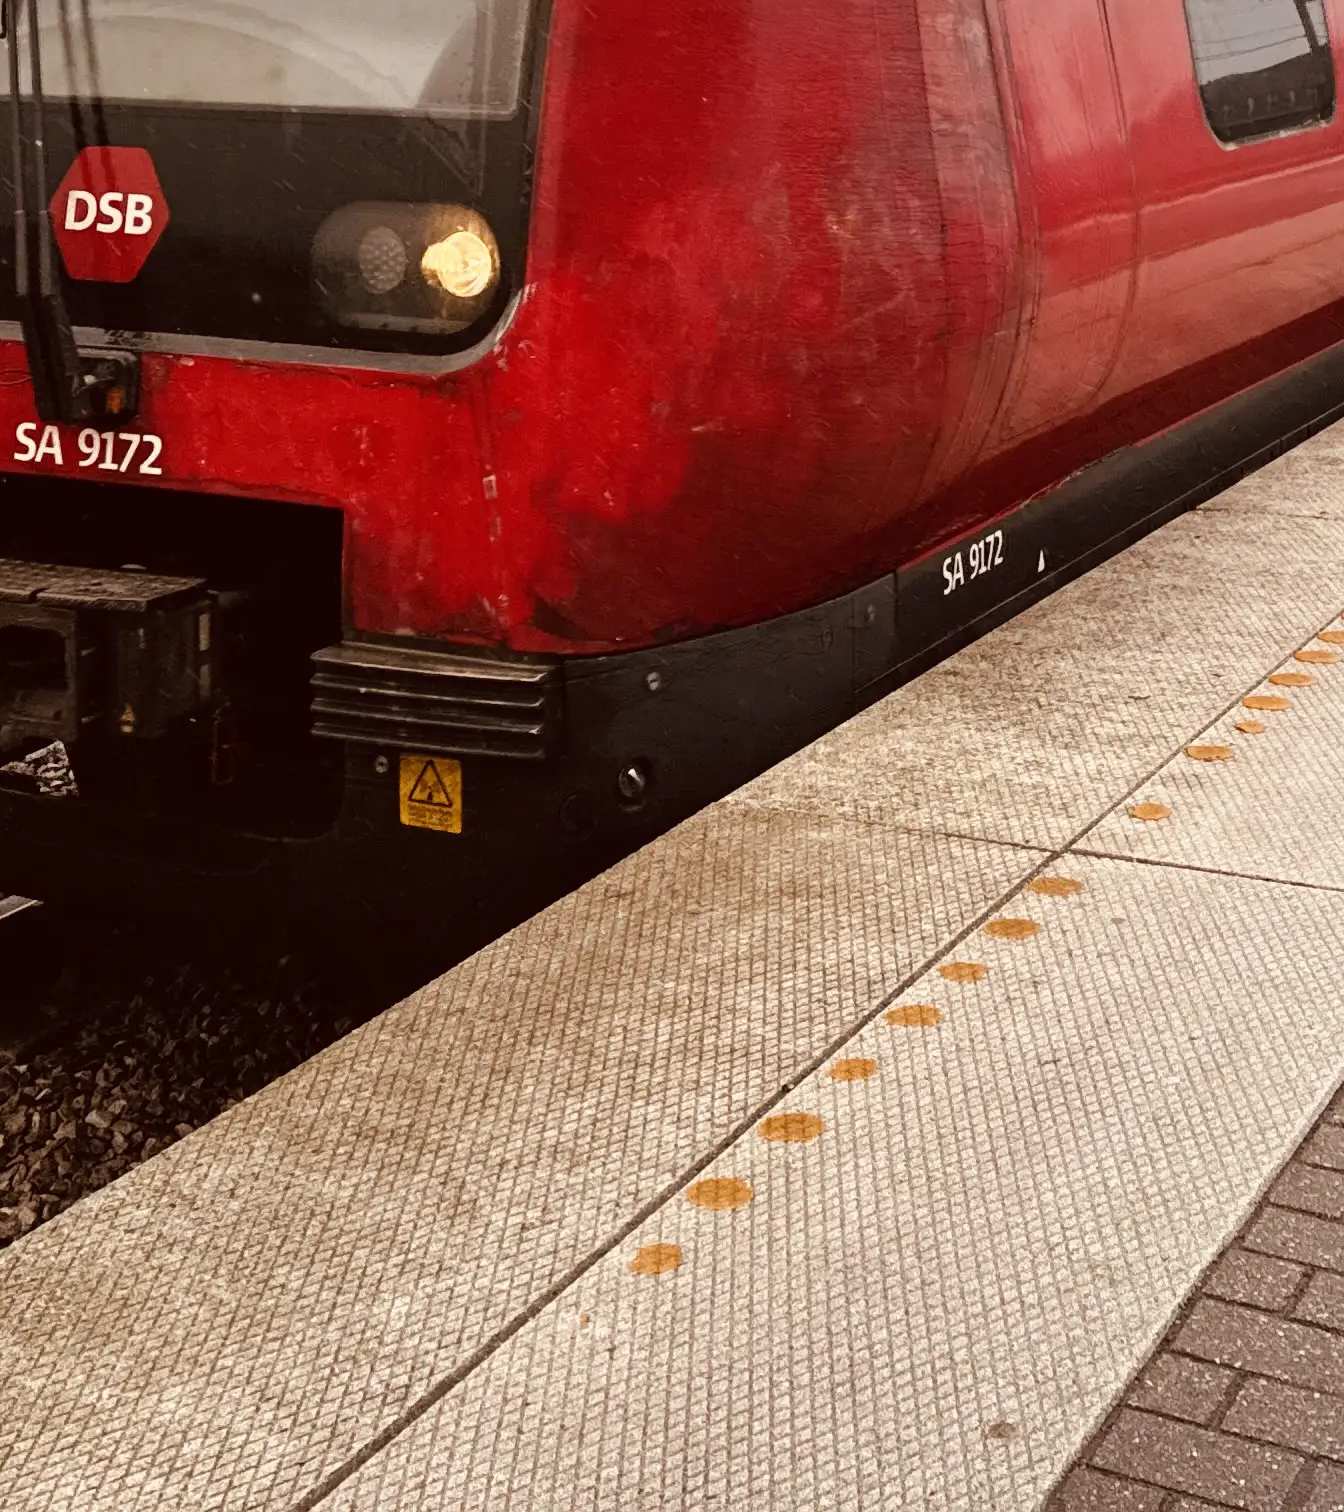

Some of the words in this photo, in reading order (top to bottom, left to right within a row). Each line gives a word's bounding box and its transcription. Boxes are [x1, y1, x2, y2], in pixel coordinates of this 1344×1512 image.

[64, 190, 153, 235] DSB
[13, 422, 64, 466] SA
[77, 428, 163, 476] 9172
[942, 550, 965, 596] SA
[969, 529, 1004, 580] 9172
